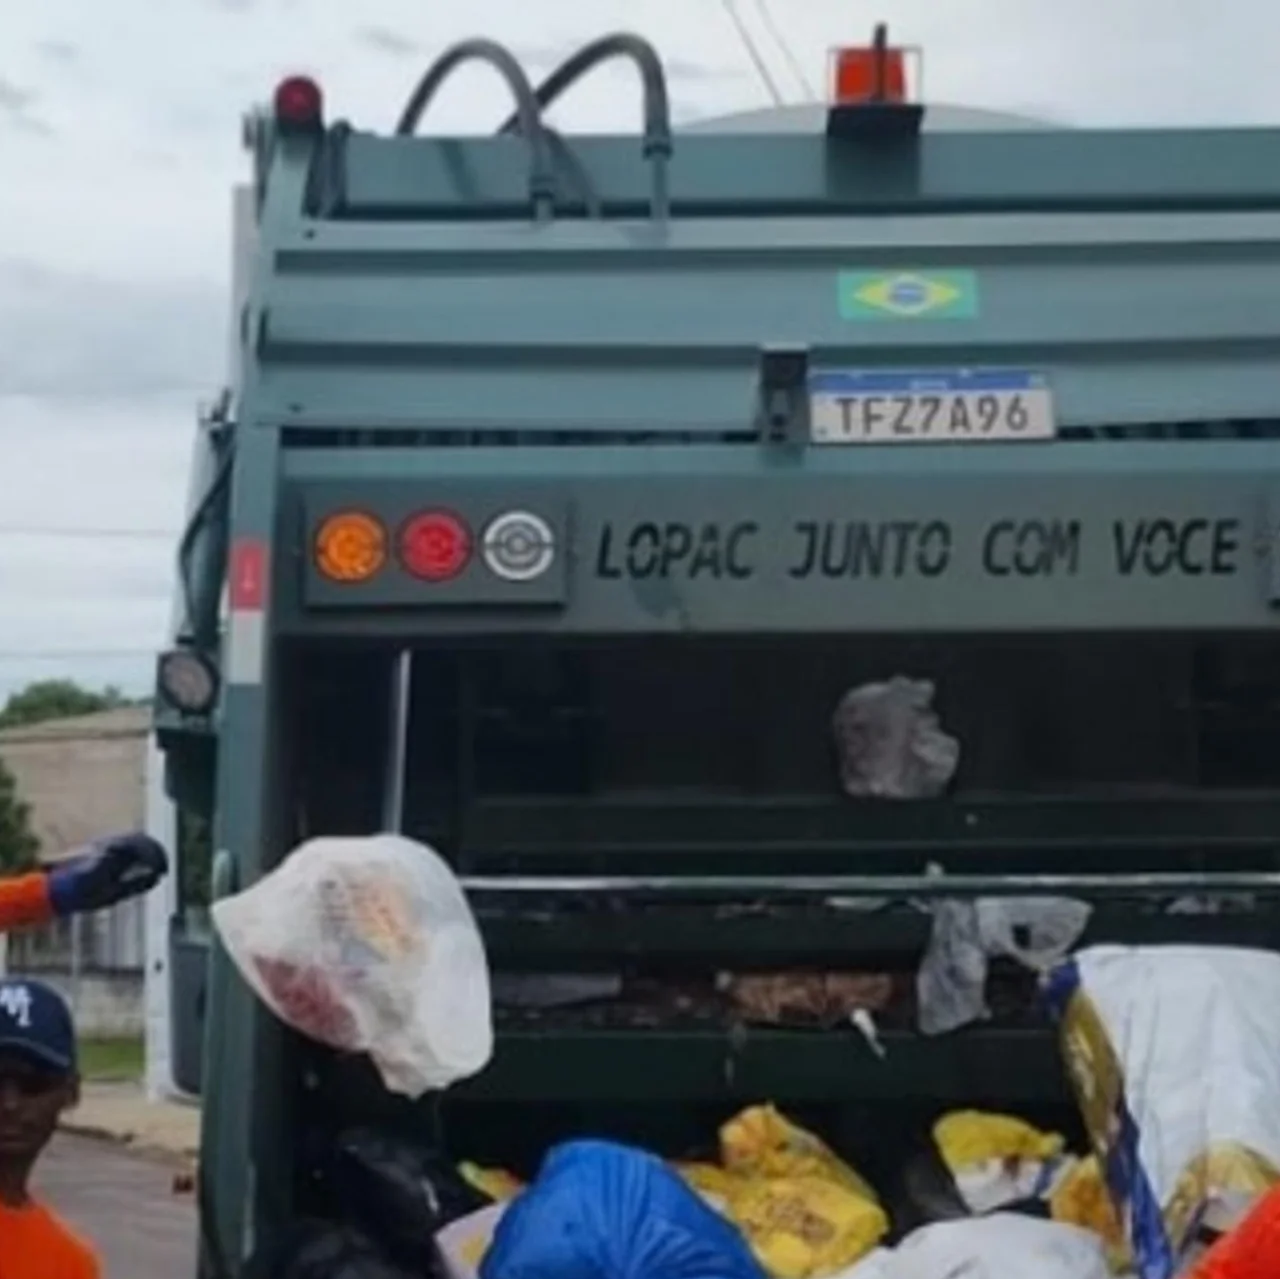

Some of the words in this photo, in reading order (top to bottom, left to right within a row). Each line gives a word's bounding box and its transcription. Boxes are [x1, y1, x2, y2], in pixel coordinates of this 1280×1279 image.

[835, 393, 1029, 435] TFZ7A96
[596, 521, 759, 579] LOPAC
[788, 519, 952, 578] JUNTO
[982, 518, 1081, 577] COM
[1114, 517, 1240, 576] VOCE
